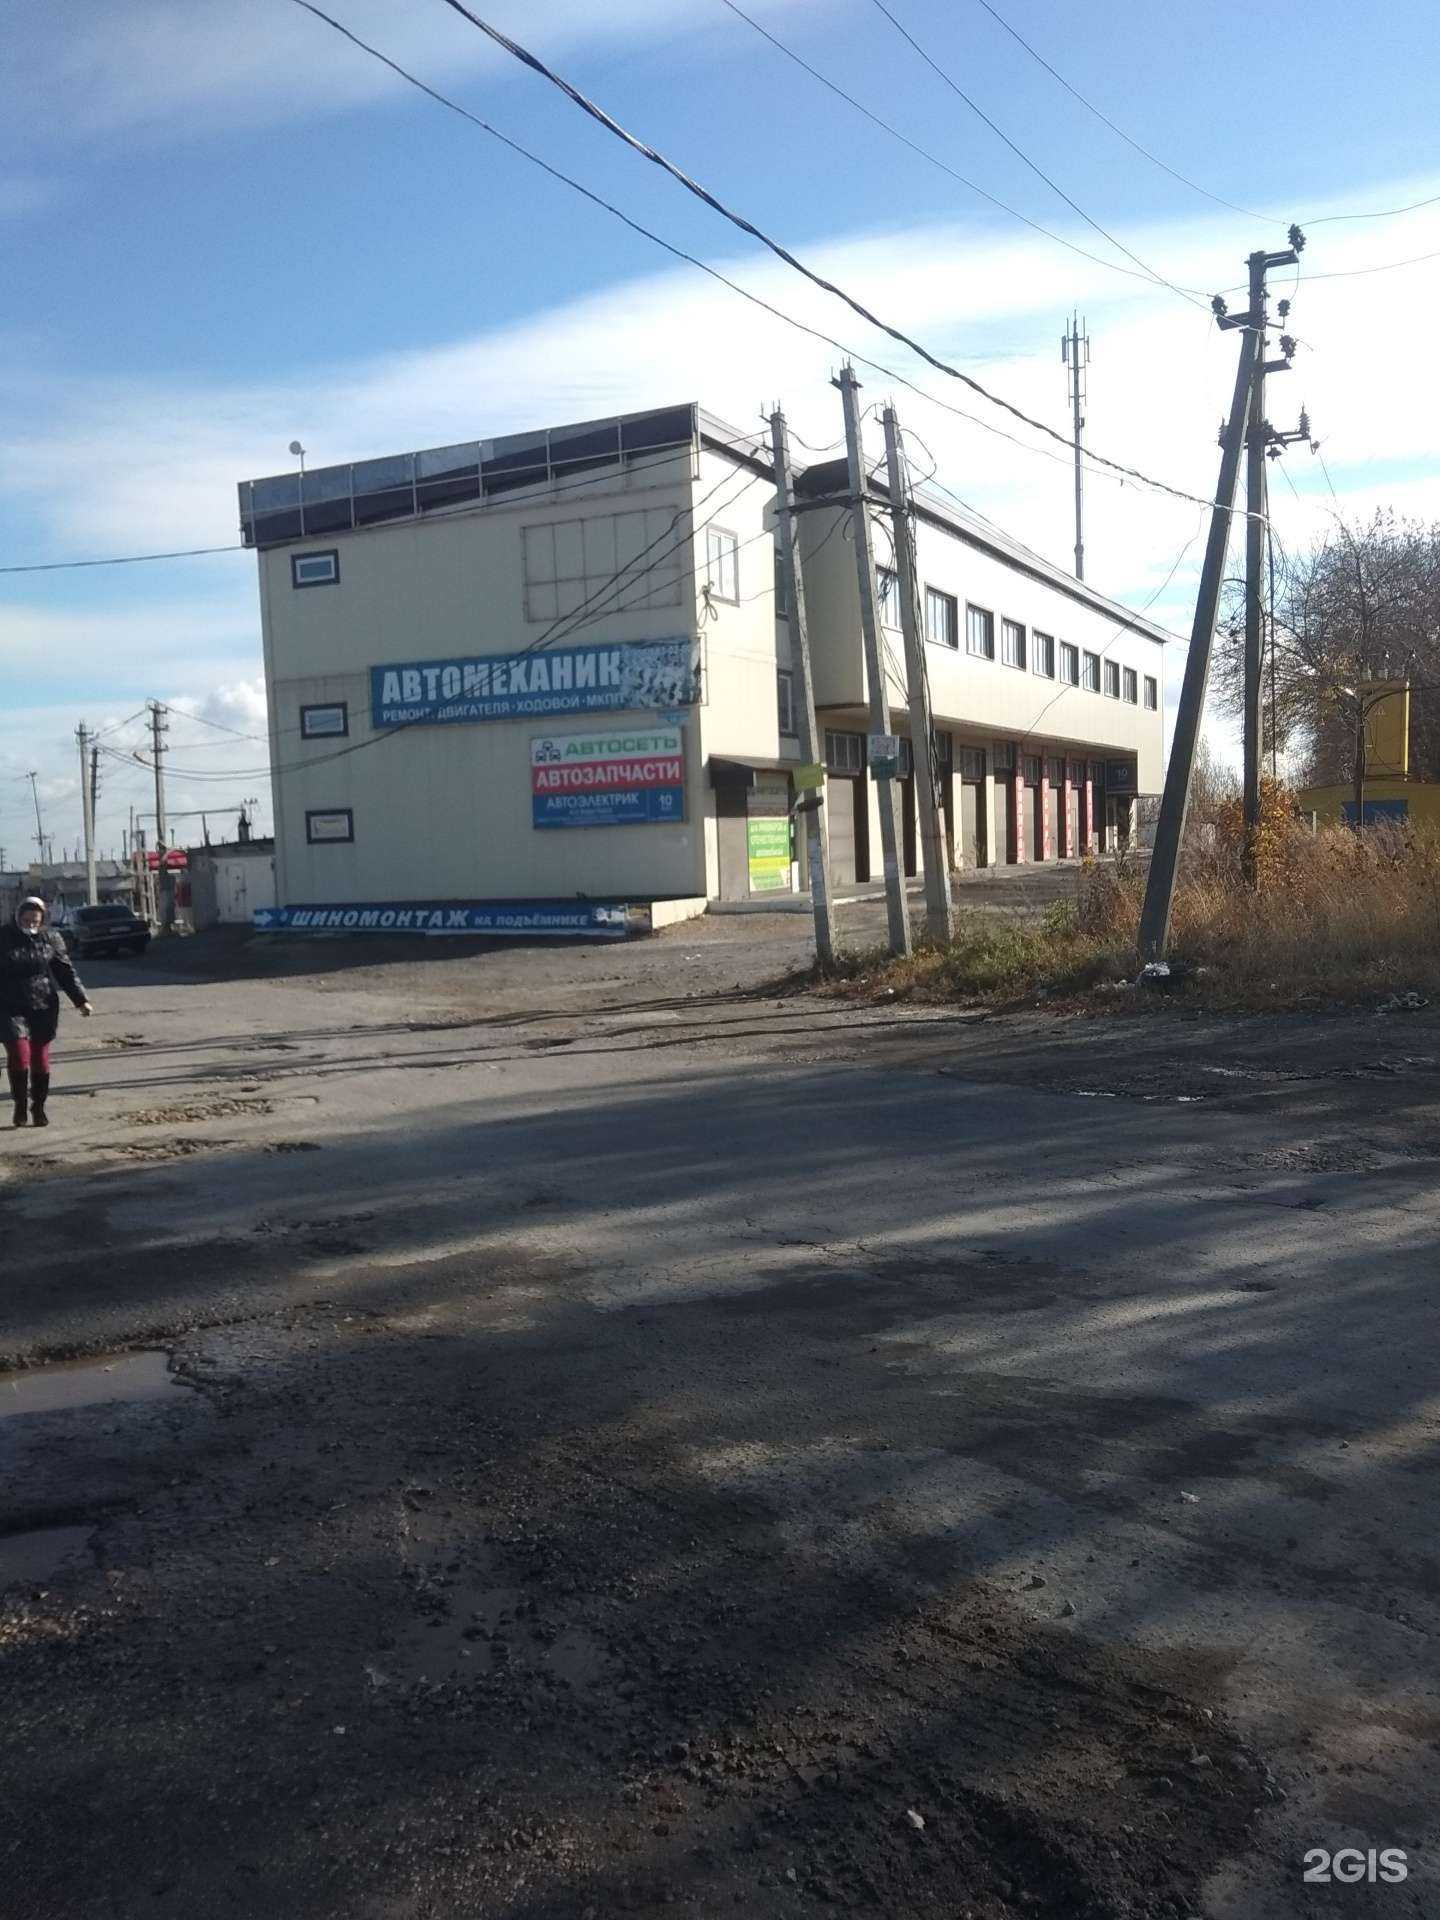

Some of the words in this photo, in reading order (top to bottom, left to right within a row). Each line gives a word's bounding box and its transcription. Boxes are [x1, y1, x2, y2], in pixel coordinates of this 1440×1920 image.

[382, 652, 621, 705] АВТОМЕХАНИК
[438, 703, 510, 720] ДВИГАТЕЛЯ
[565, 736, 677, 756] АВТОСЕТЬ
[536, 762, 680, 787] АВТОЗАПЧАСТИ
[547, 793, 640, 809] АВТОЭЛЕКТРИК
[290, 910, 470, 927] ШИНОМОНТАЖ
